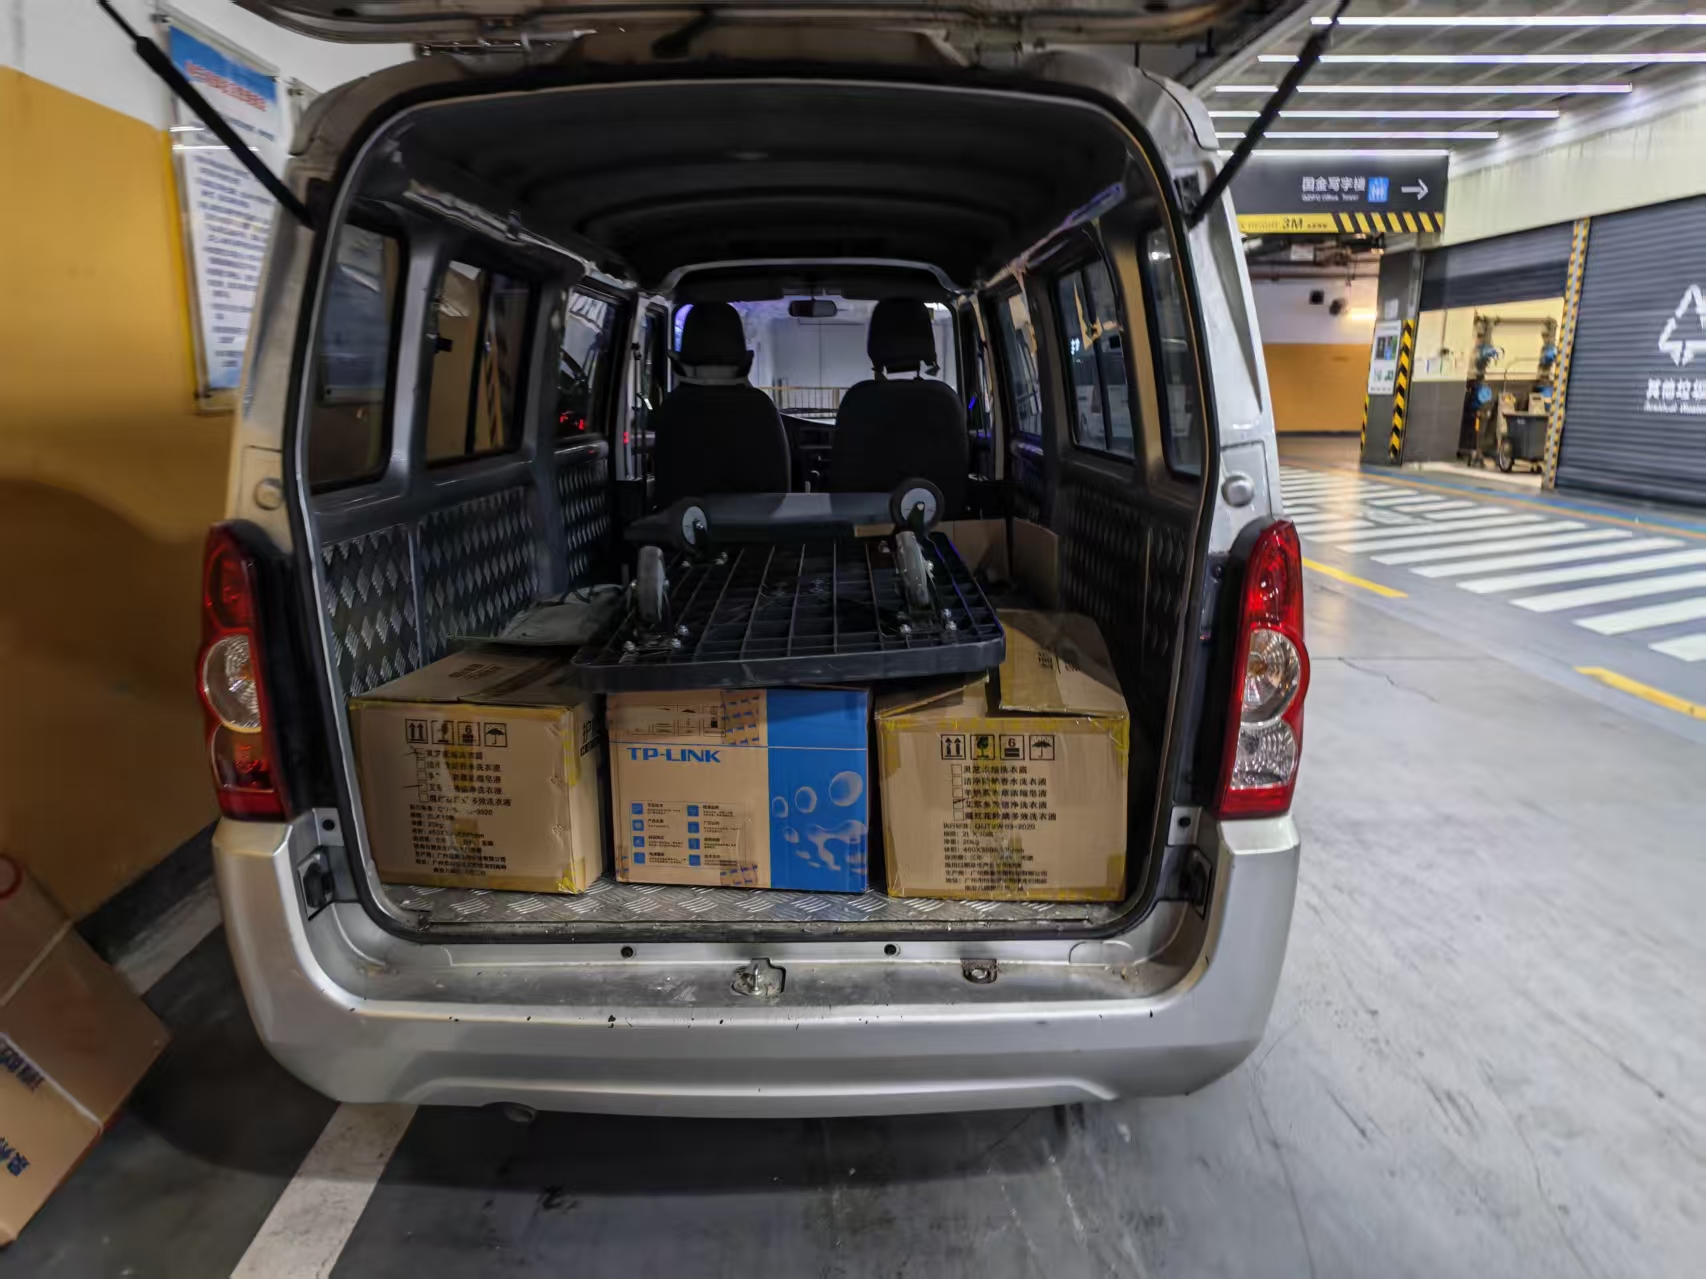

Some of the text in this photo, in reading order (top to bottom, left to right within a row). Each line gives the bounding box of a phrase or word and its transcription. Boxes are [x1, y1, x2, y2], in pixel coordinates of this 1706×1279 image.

[1302, 176, 1366, 192] 国金写字楼
[1283, 217, 1303, 230] 3M
[1008, 738, 1016, 748] 6
[626, 747, 721, 763] TP-LINK
